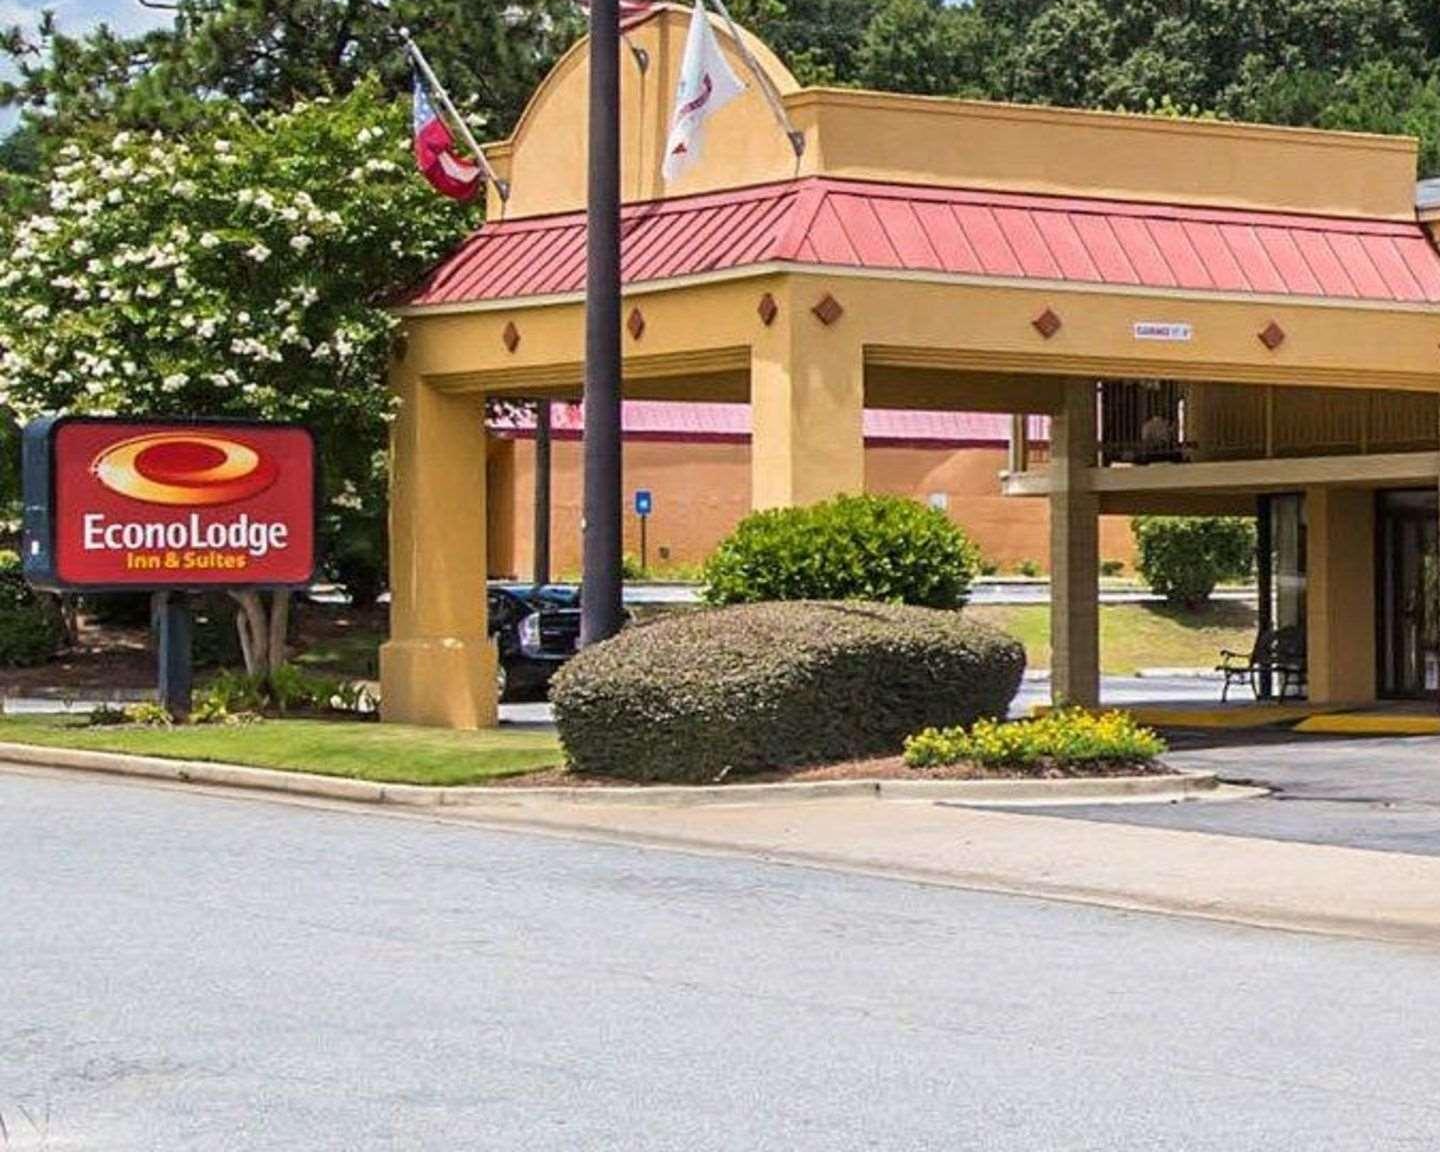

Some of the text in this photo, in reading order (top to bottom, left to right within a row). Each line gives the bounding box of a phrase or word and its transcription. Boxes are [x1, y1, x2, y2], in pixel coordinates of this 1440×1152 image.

[84, 514, 288, 555] EconoLodge
[127, 552, 246, 569] Inn & Suites
